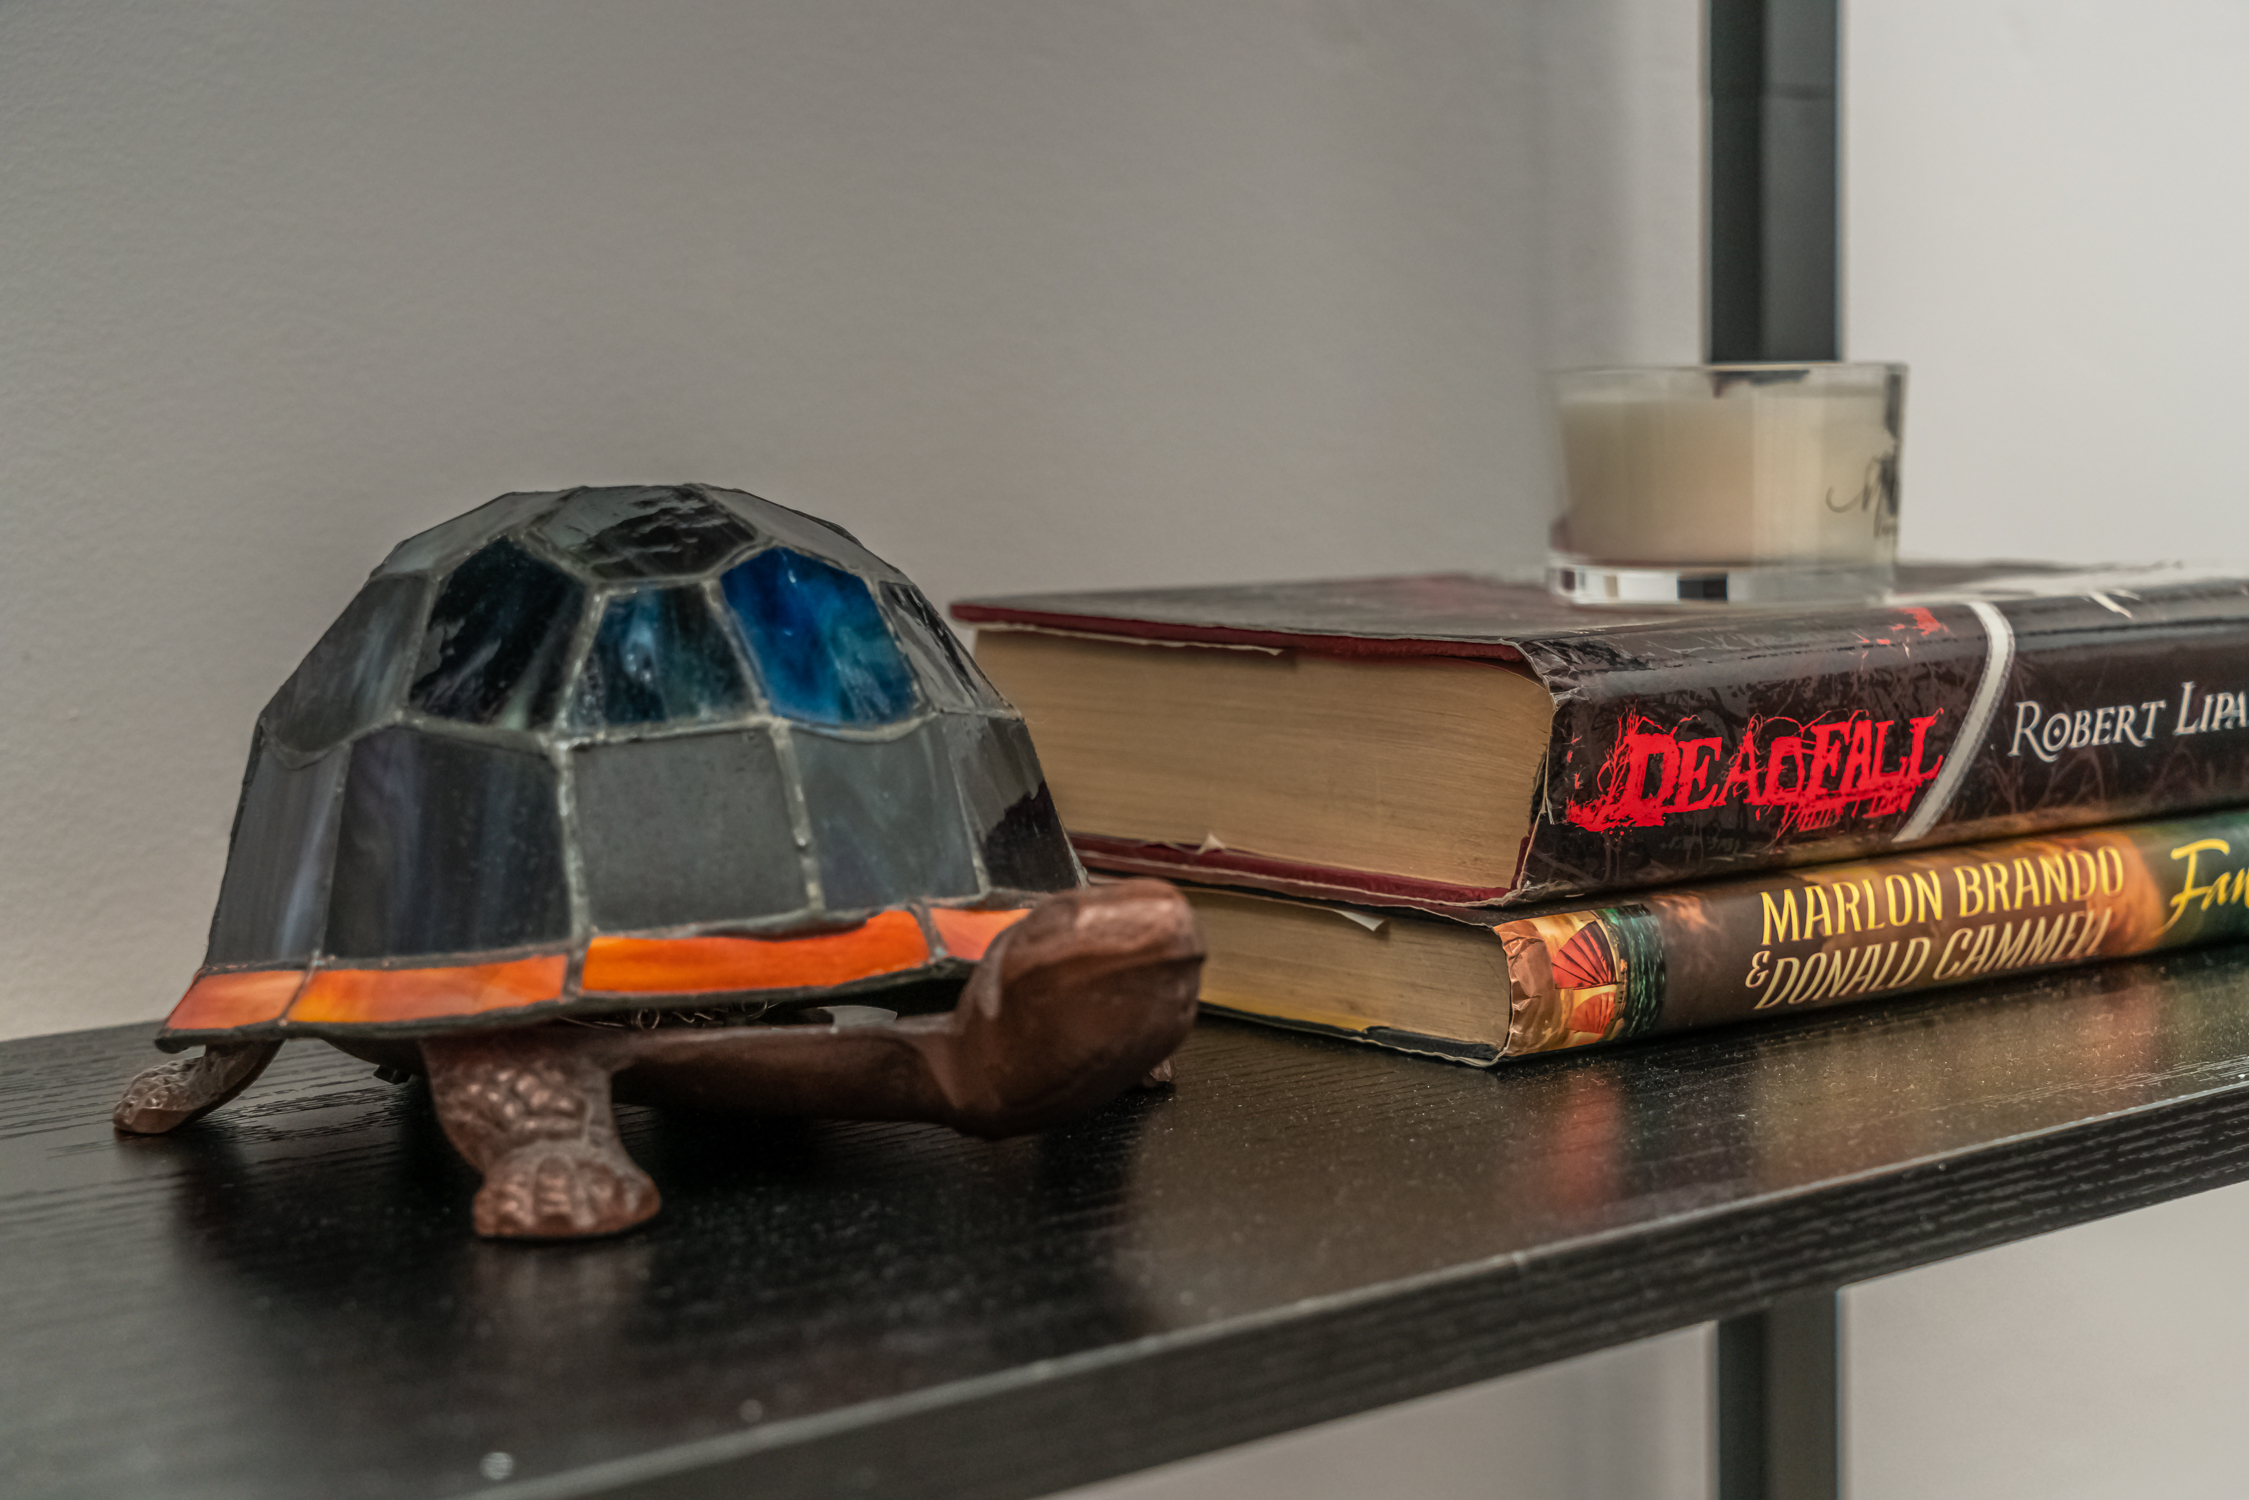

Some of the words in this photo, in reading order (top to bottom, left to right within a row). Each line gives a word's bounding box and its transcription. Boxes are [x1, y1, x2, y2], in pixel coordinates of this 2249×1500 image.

[1575, 702, 1945, 835] DEADFALL
[2007, 699, 2167, 763] ROBERT
[1759, 869, 1943, 946] MARLON
[1953, 846, 2124, 918] BRANDO
[1754, 936, 1931, 1010] DONALD
